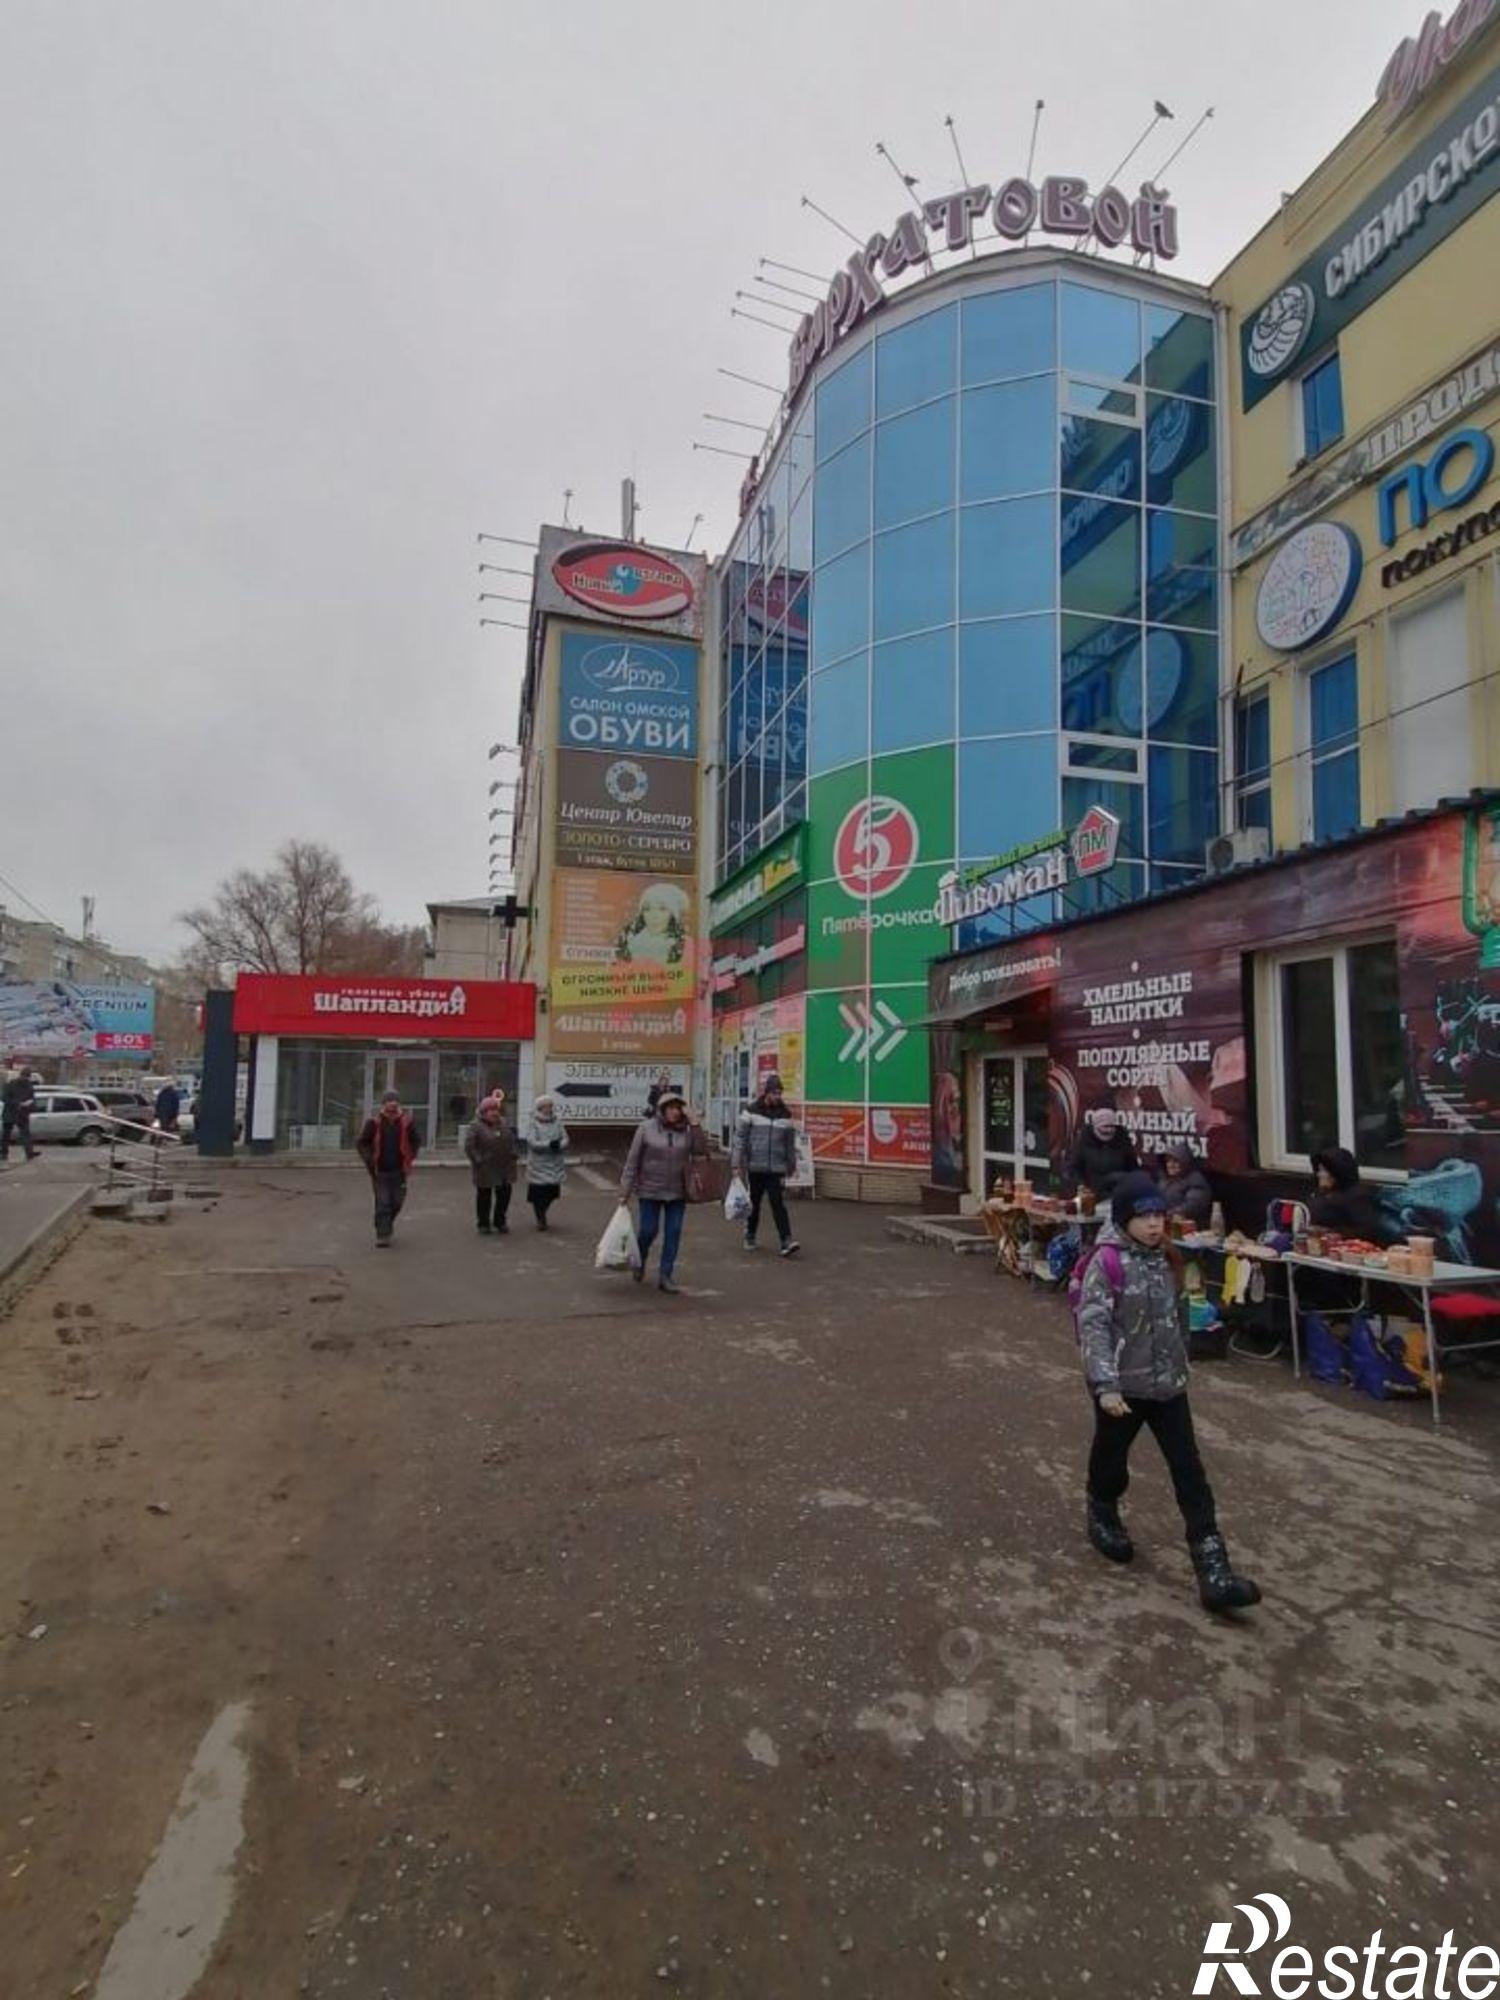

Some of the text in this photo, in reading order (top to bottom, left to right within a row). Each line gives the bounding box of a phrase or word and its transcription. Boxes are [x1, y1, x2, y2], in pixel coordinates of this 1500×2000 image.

[1325, 104, 1500, 298] СИБИРСКО
[596, 646, 666, 688] Артур
[570, 696, 691, 719] САЛОН ОМСКОЙ
[569, 713, 689, 750] ОБУВИ
[561, 801, 692, 829] Центр Ювелир
[854, 803, 900, 880] 5
[934, 847, 1068, 925] Пивоман
[822, 905, 934, 936] Пятёрочка
[341, 989, 447, 999] головные уборы
[949, 970, 980, 992] Добро
[1083, 972, 1192, 1006] ХМЕЛЬНЫЕ
[1091, 997, 1184, 1025] НАПИТКИ
[1078, 1040, 1210, 1067] ПОПУЛЯРНЫЕ
[1107, 1064, 1168, 1087] СОРТА
[555, 1103, 648, 1117] РАДИОТОВ
[1143, 1133, 1208, 1158] РЫЫ
